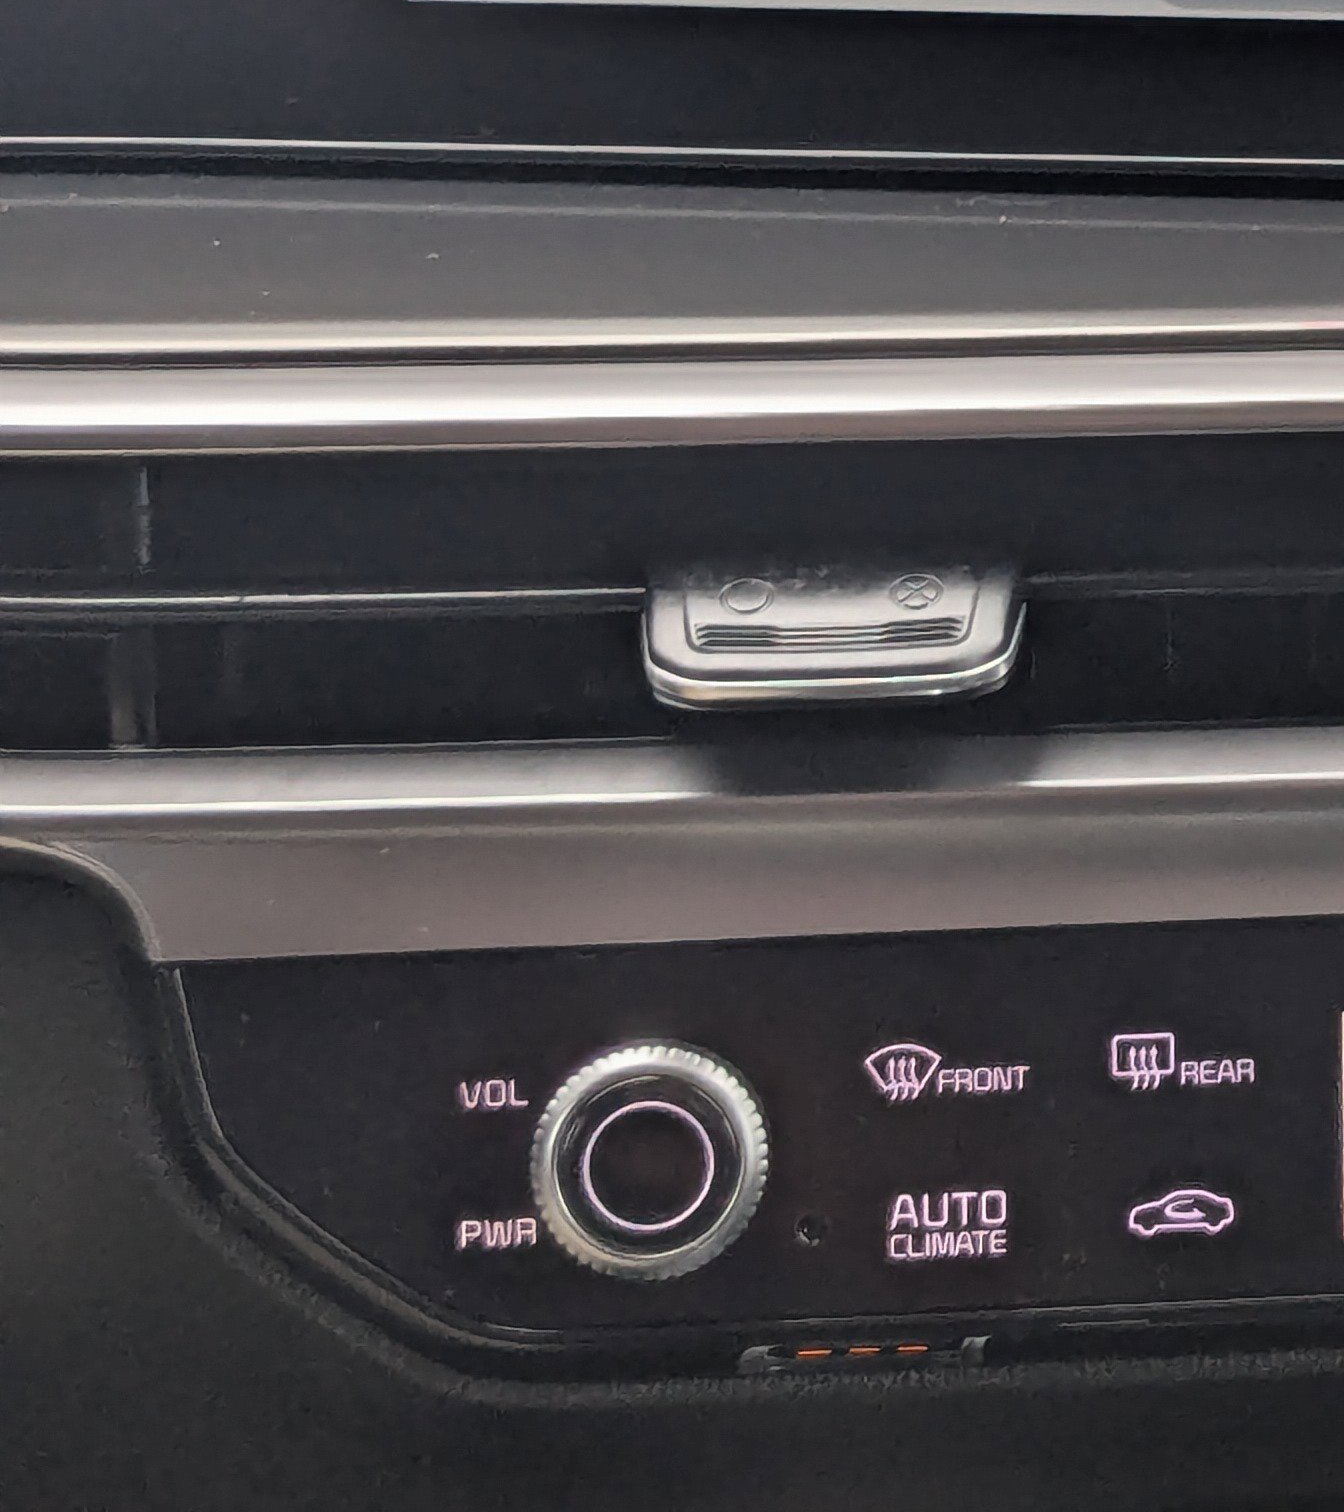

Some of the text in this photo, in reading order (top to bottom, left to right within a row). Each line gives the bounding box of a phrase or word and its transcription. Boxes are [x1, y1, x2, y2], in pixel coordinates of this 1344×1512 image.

[937, 1063, 1030, 1093] FRONT
[1180, 1058, 1255, 1085] REAR
[459, 1079, 529, 1109] VOL
[889, 1189, 1007, 1230] AUTO
[460, 1217, 537, 1248] PWR
[888, 1228, 1008, 1260] CLIMATE
